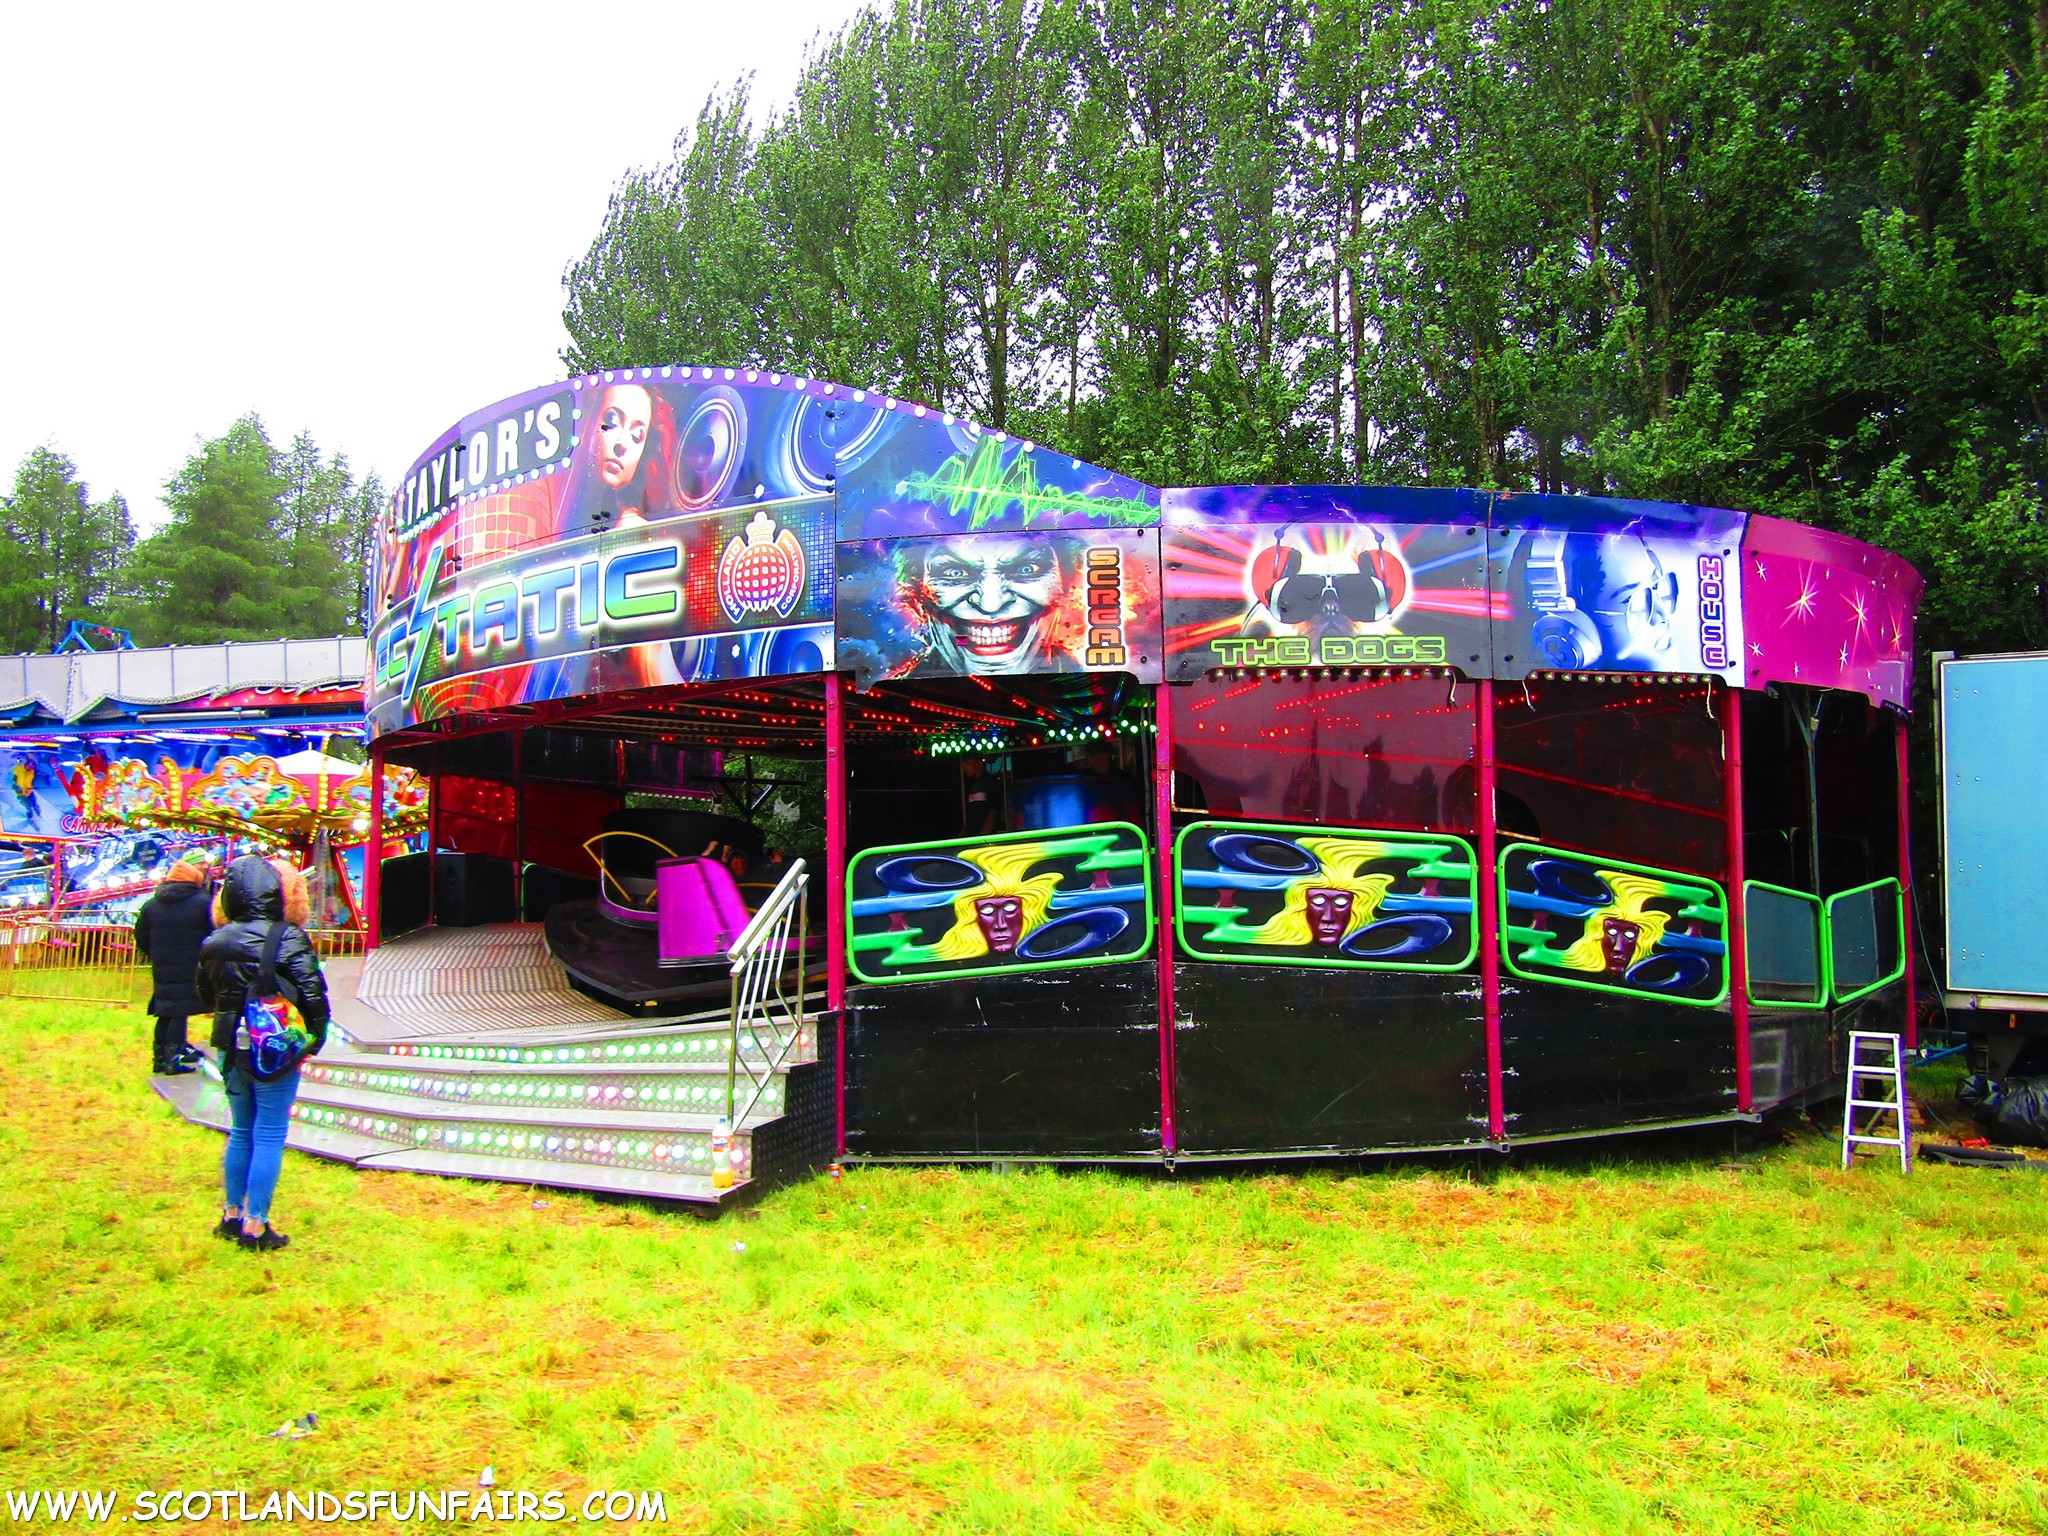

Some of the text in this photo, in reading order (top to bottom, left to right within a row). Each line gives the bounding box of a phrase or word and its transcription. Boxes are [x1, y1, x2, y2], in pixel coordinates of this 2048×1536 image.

[406, 401, 561, 526] TAYLOR'S
[376, 546, 678, 700] ECSTATIC
[723, 543, 742, 616] HOLLAND
[781, 537, 801, 610] CORPORATION
[1086, 547, 1125, 665] SCREAM
[1698, 556, 1727, 668] HOUSE
[1210, 635, 1446, 665] THE DOGS
